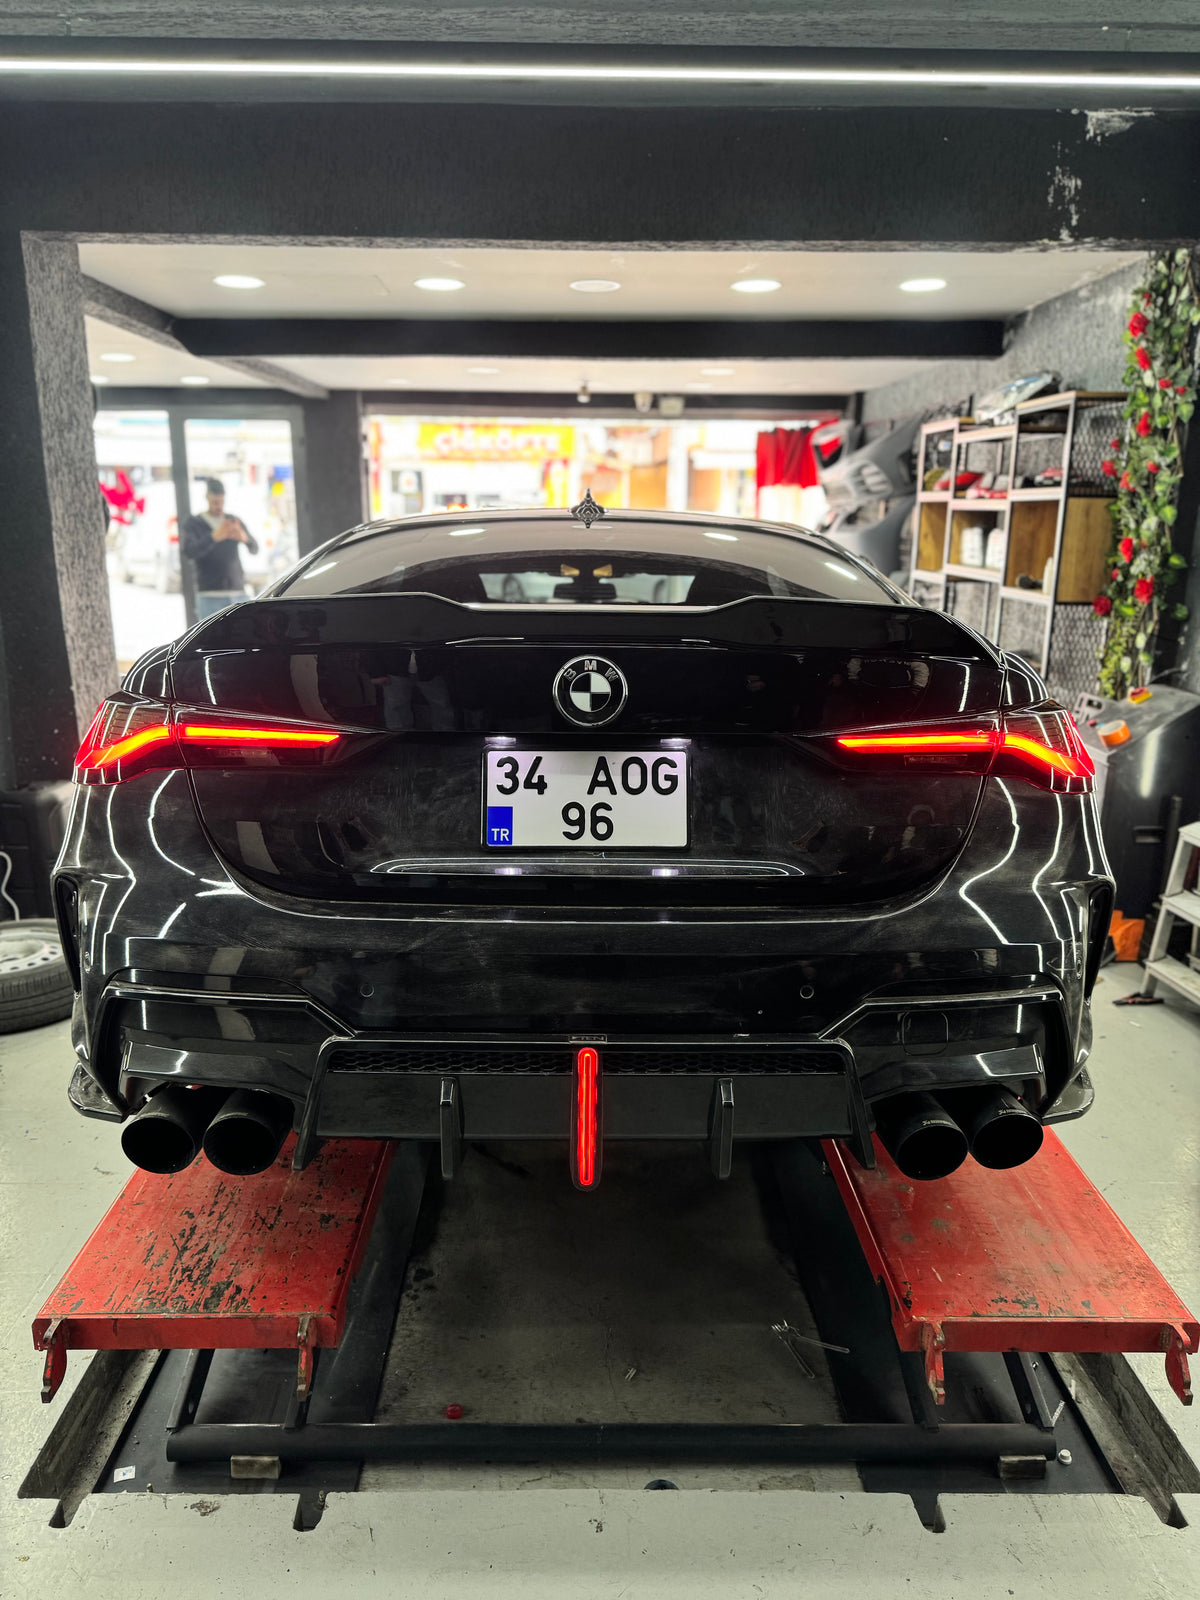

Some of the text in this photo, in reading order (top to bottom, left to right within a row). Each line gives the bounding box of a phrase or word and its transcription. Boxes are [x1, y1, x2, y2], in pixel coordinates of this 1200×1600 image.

[563, 659, 619, 682] BMW
[496, 756, 679, 796] 34 AOG
[491, 828, 510, 842] TR
[561, 801, 614, 841] 96
